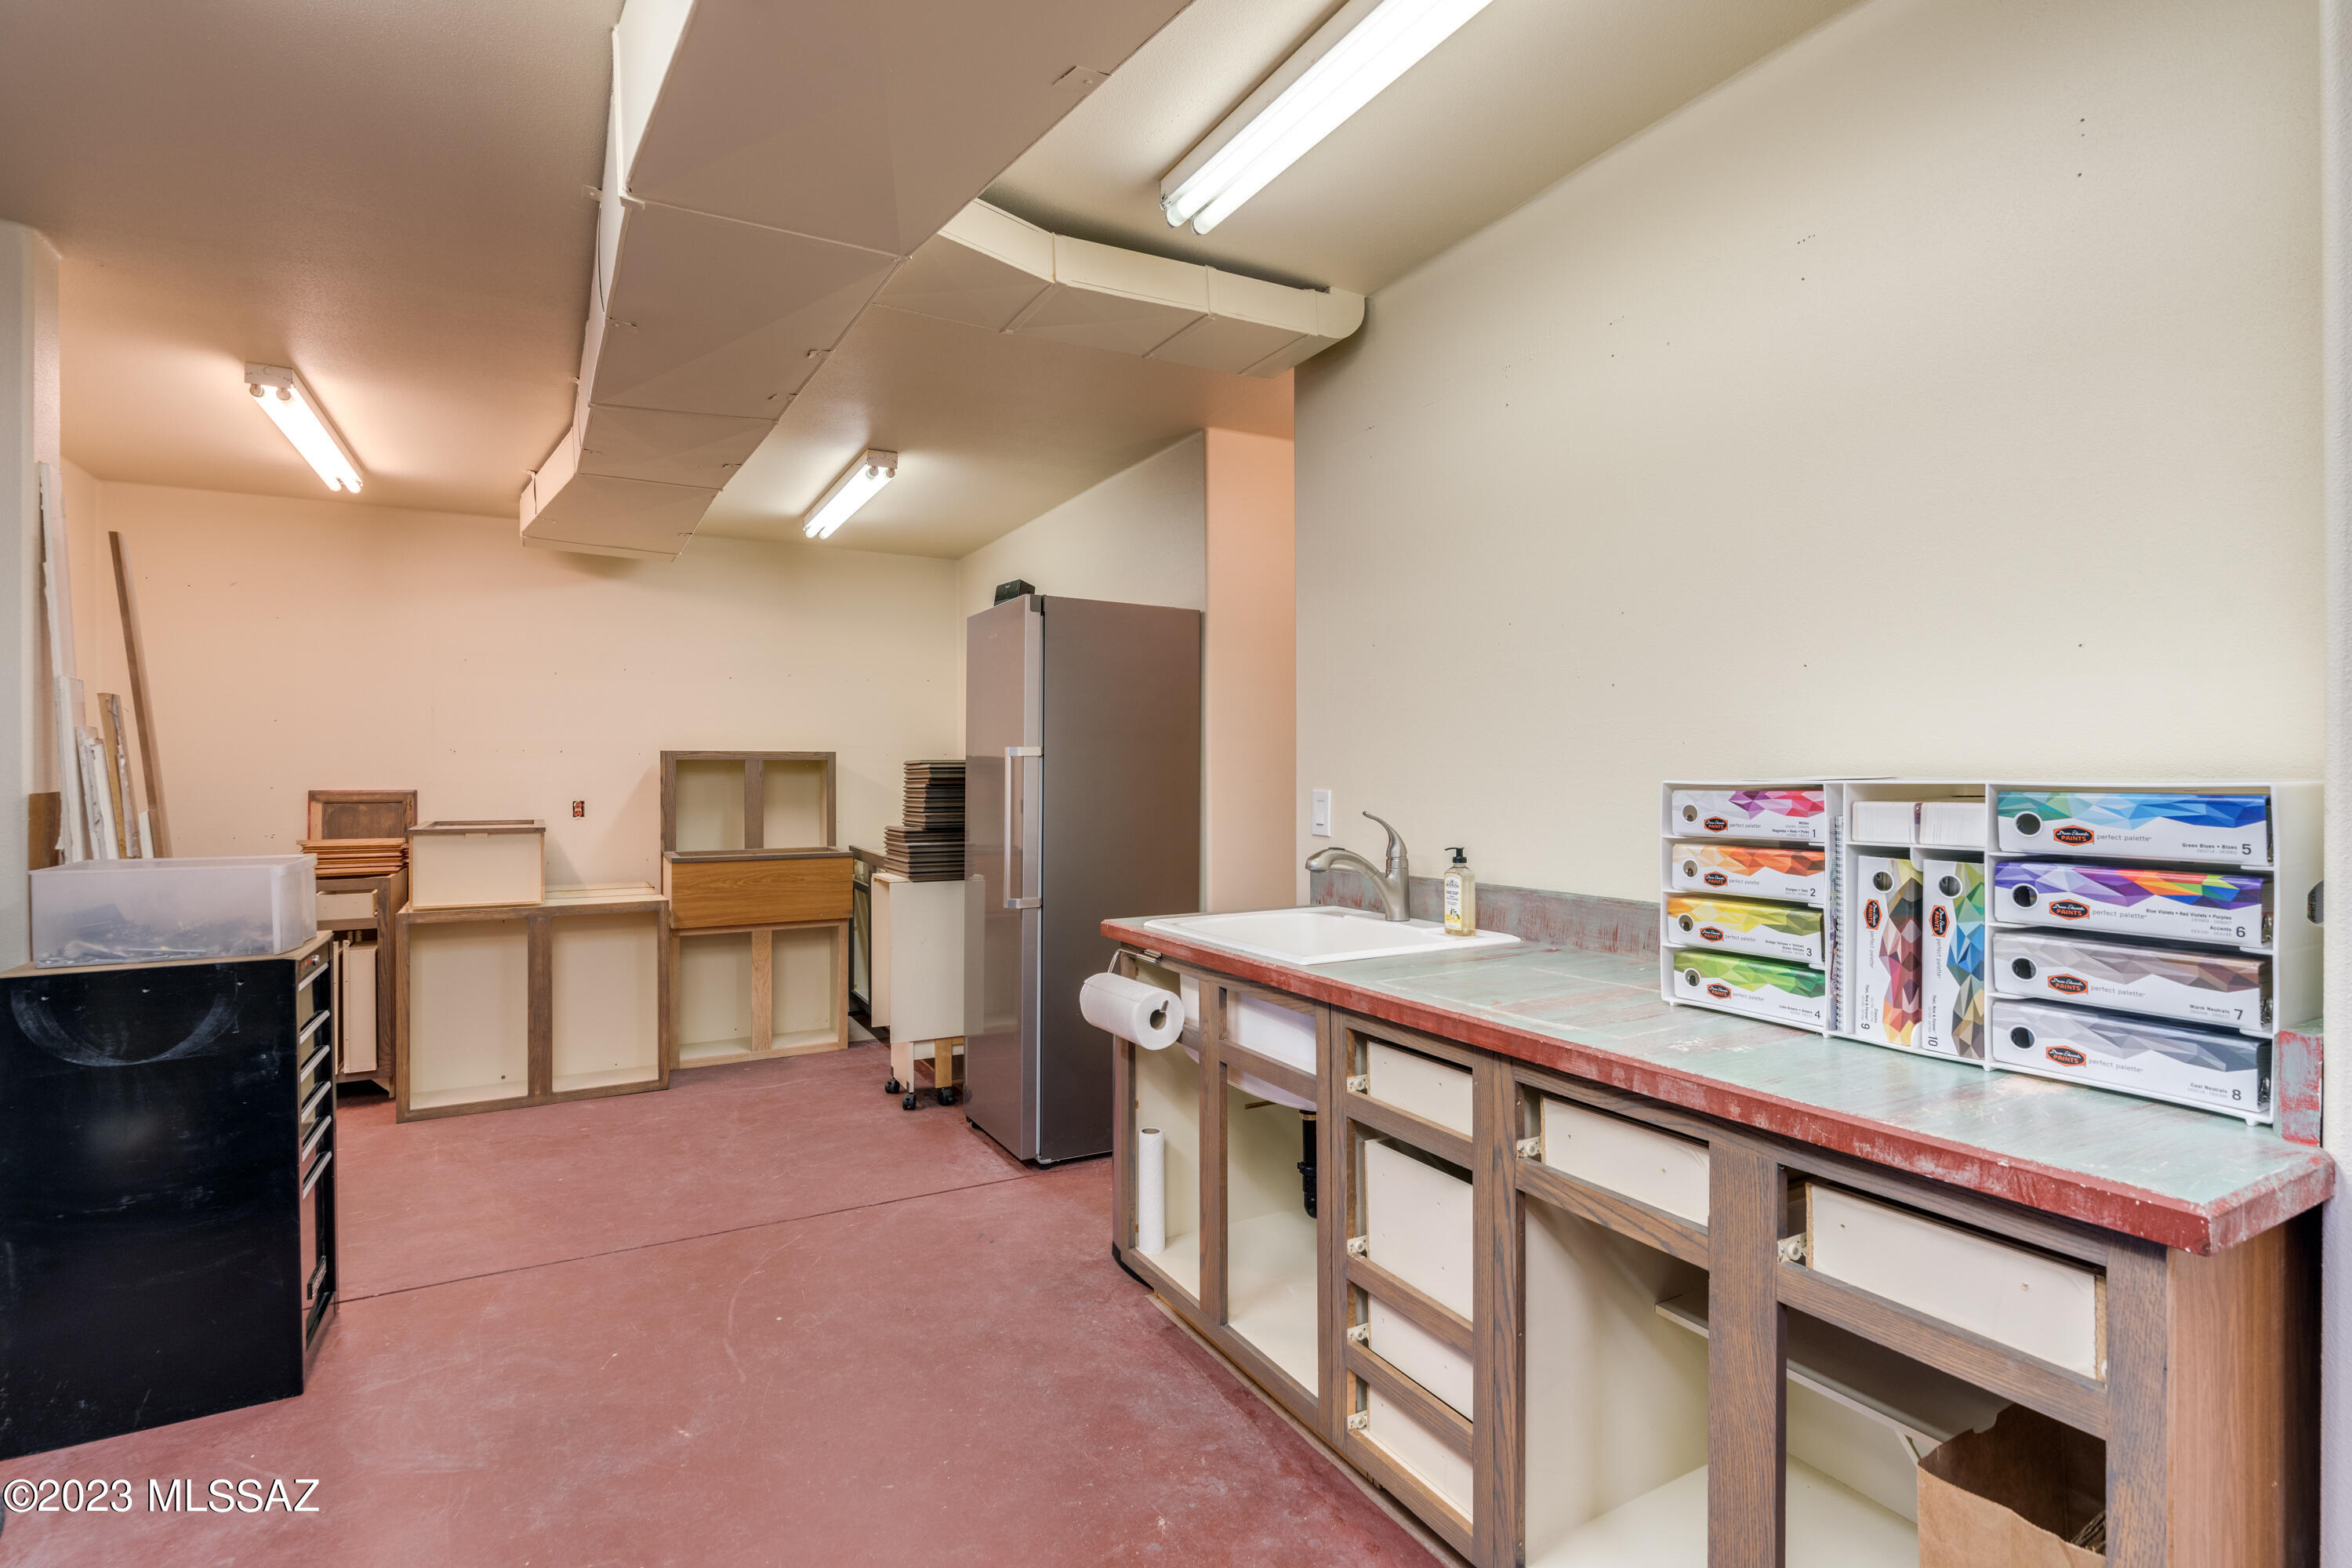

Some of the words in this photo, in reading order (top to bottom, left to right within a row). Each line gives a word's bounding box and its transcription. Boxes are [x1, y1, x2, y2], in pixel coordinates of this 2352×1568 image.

[1812, 829, 1816, 837] 1
[2241, 844, 2252, 855] 5
[1810, 888, 1816, 897] 2
[2092, 909, 2118, 918] perfect
[2236, 926, 2246, 938] 6
[1806, 948, 1813, 956] 3
[2091, 985, 2115, 993] perfect
[2206, 1006, 2230, 1014] Neutrals
[2234, 1008, 2244, 1020] 7
[1814, 1011, 1820, 1019] 4
[1928, 1036, 1938, 1047] 10
[2053, 1054, 2079, 1063] PAINTS
[2089, 1058, 2114, 1067] perfect
[2204, 1085, 2227, 1094] Neutrals
[2232, 1089, 2241, 1101] 8
